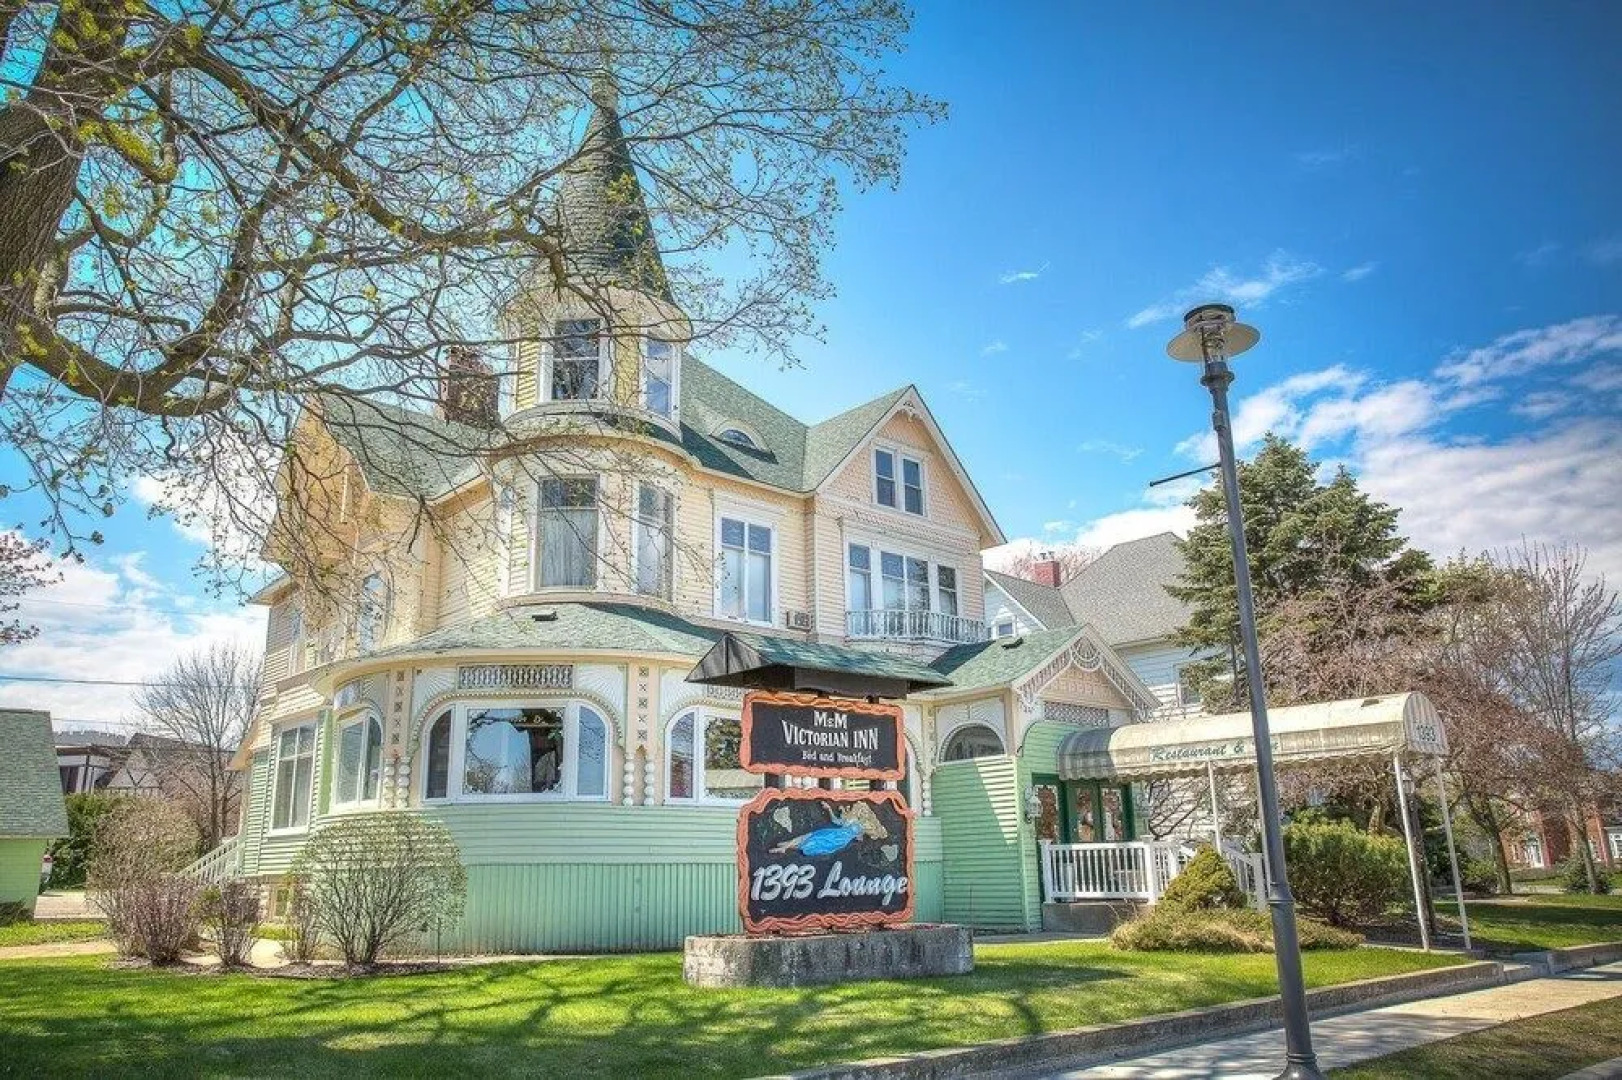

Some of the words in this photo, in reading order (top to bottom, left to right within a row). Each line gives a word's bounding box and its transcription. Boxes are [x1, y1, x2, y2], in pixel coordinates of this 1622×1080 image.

[781, 719, 849, 748] VICTORIAN
[853, 727, 879, 750] INN
[802, 750, 817, 760] Bed
[819, 752, 835, 762] and
[1150, 744, 1227, 761] Restaurant
[1233, 740, 1245, 754] &
[751, 863, 816, 900] 1393
[817, 861, 908, 905] Lounge
